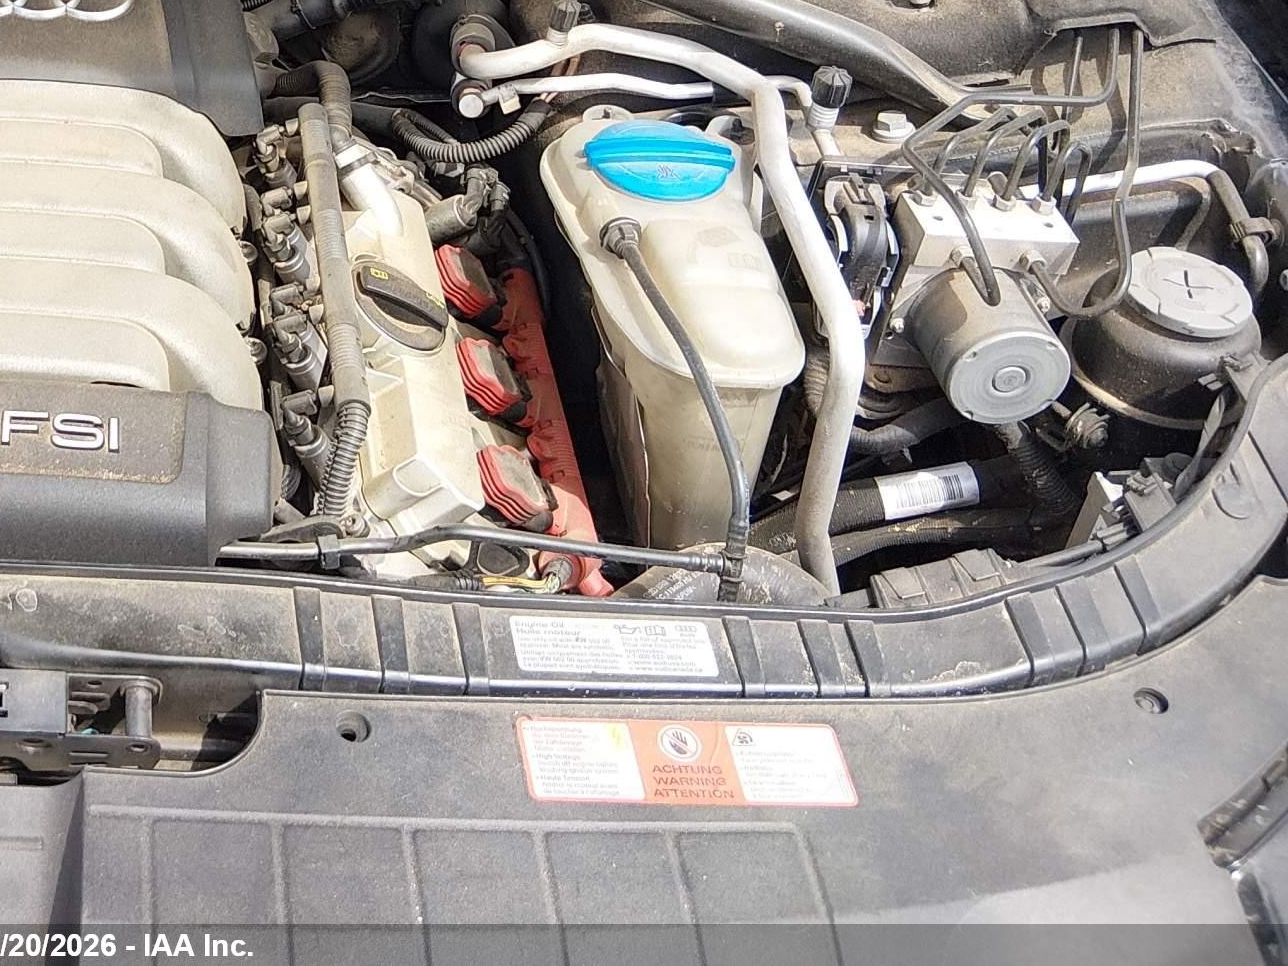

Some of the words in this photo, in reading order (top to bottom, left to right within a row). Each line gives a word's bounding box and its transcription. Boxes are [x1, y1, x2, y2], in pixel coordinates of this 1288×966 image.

[514, 621, 549, 629] Engine
[652, 764, 723, 775] ACHTUNG
[652, 776, 727, 786] WARNING
[654, 788, 735, 799] ATTENTION
